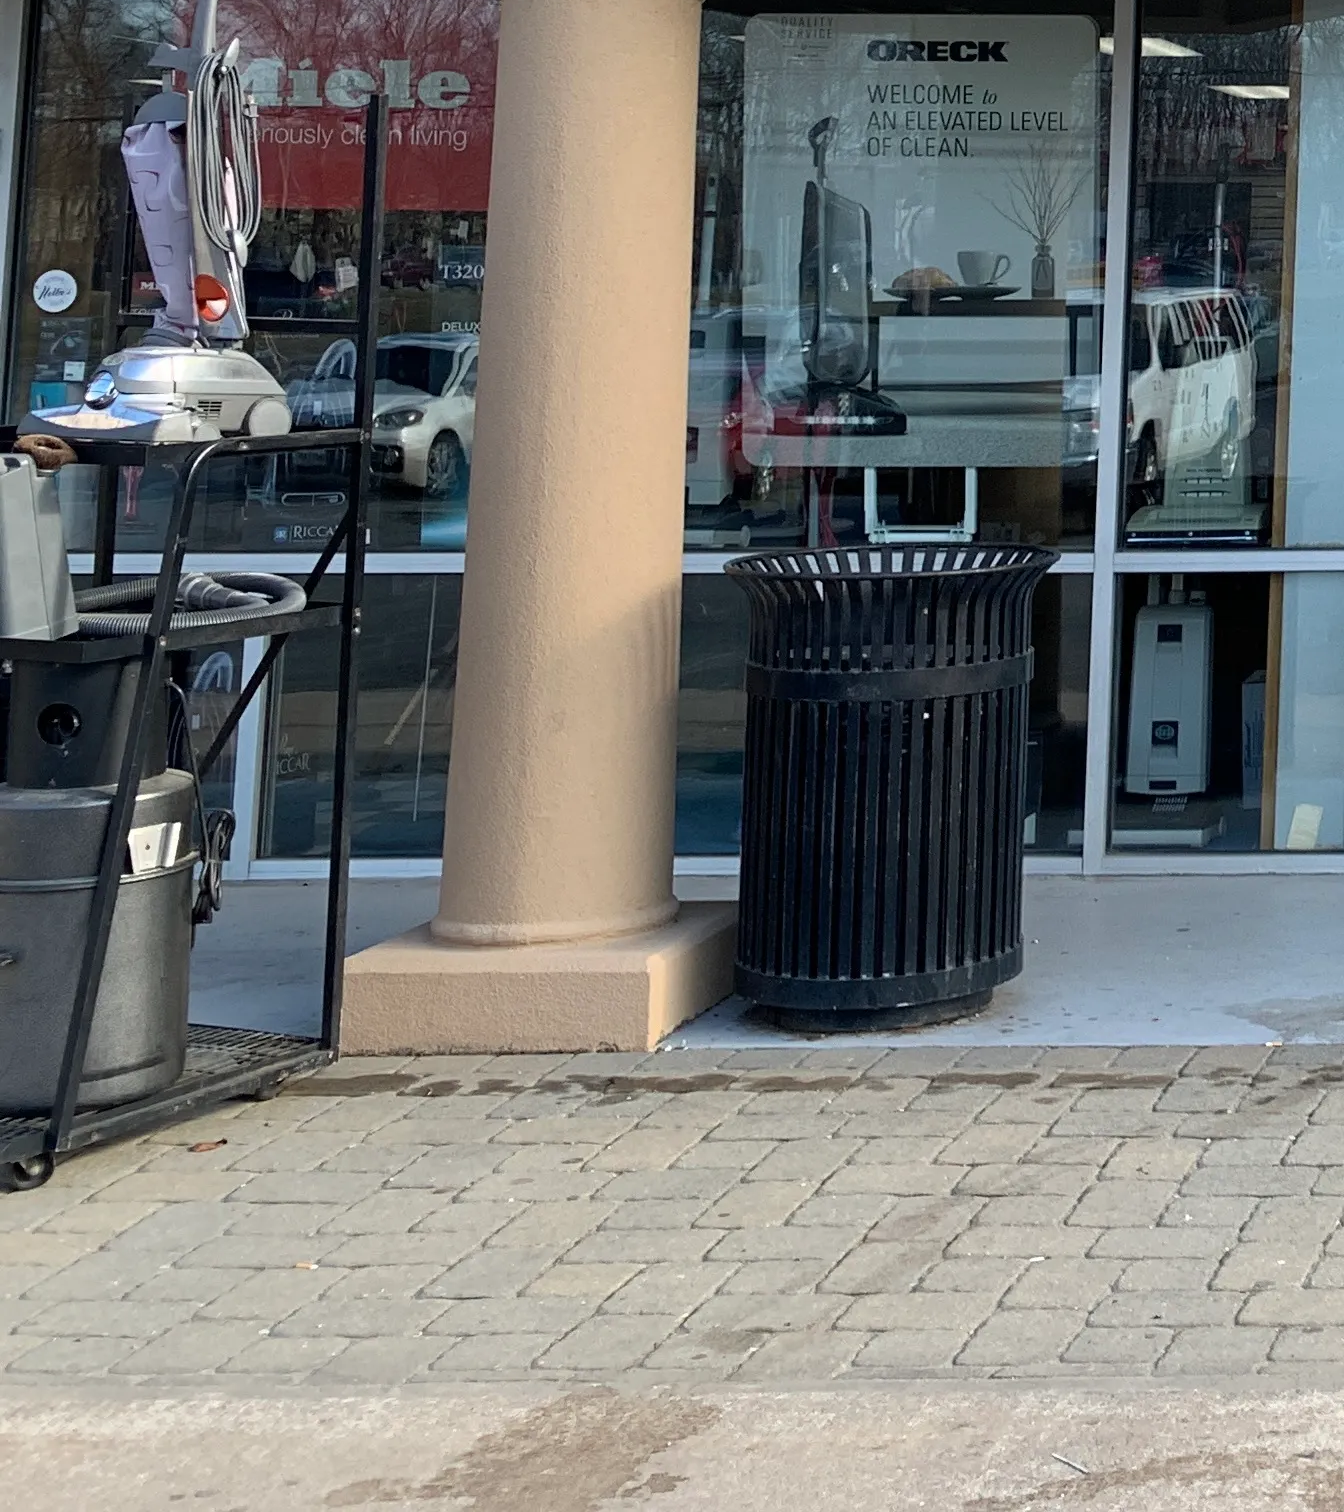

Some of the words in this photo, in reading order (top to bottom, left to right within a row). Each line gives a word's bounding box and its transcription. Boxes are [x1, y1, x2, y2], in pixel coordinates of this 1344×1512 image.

[781, 29, 832, 39] SERVICE
[867, 40, 1009, 62] ORECK
[867, 84, 974, 105] WELCOME
[982, 88, 998, 105] to
[867, 110, 897, 131] AN
[905, 110, 1003, 131] ELEVATED
[1011, 111, 1069, 132] LEVEL
[250, 124, 333, 150] eriously
[340, 125, 402, 145] clen
[411, 125, 468, 152] living
[867, 137, 892, 157] OF
[901, 138, 975, 158] CLEAN.
[441, 321, 482, 334] DELUX
[293, 525, 339, 539] RICCA
